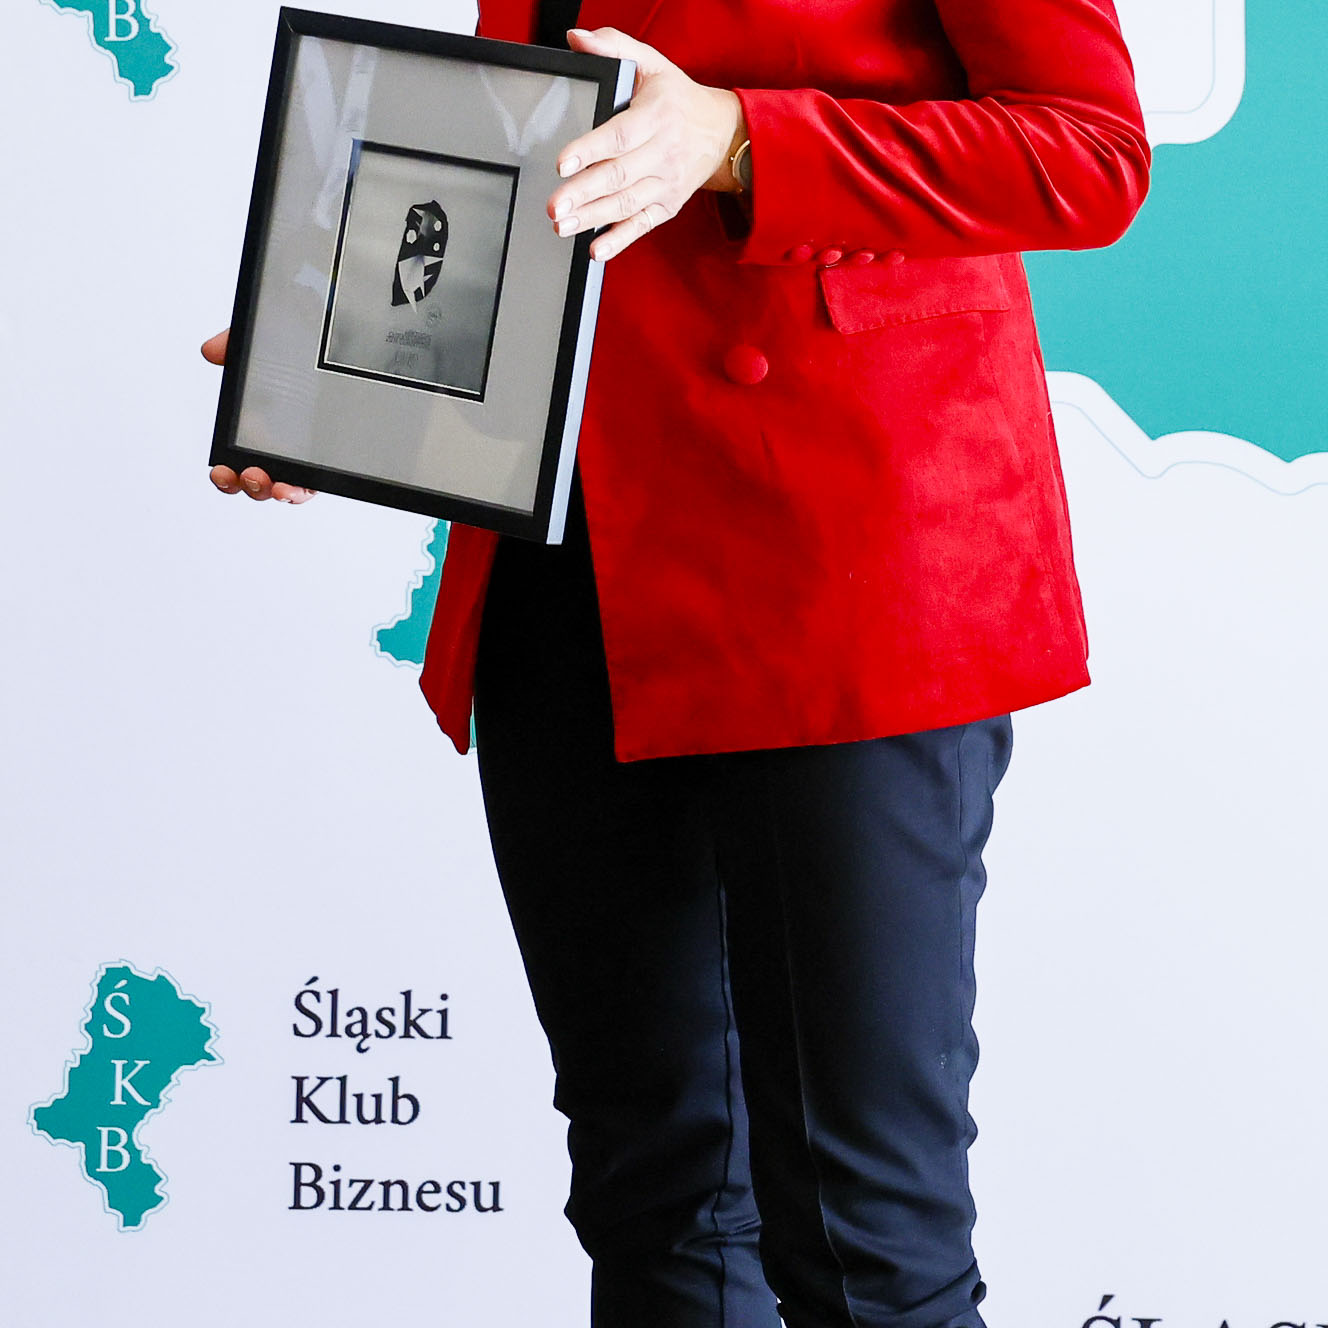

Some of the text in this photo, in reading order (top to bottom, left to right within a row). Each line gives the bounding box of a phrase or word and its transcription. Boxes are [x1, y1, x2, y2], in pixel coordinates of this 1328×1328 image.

[292, 975, 454, 1054] Śląski
[289, 1074, 422, 1126] Klub
[287, 1161, 505, 1214] Biznesu
